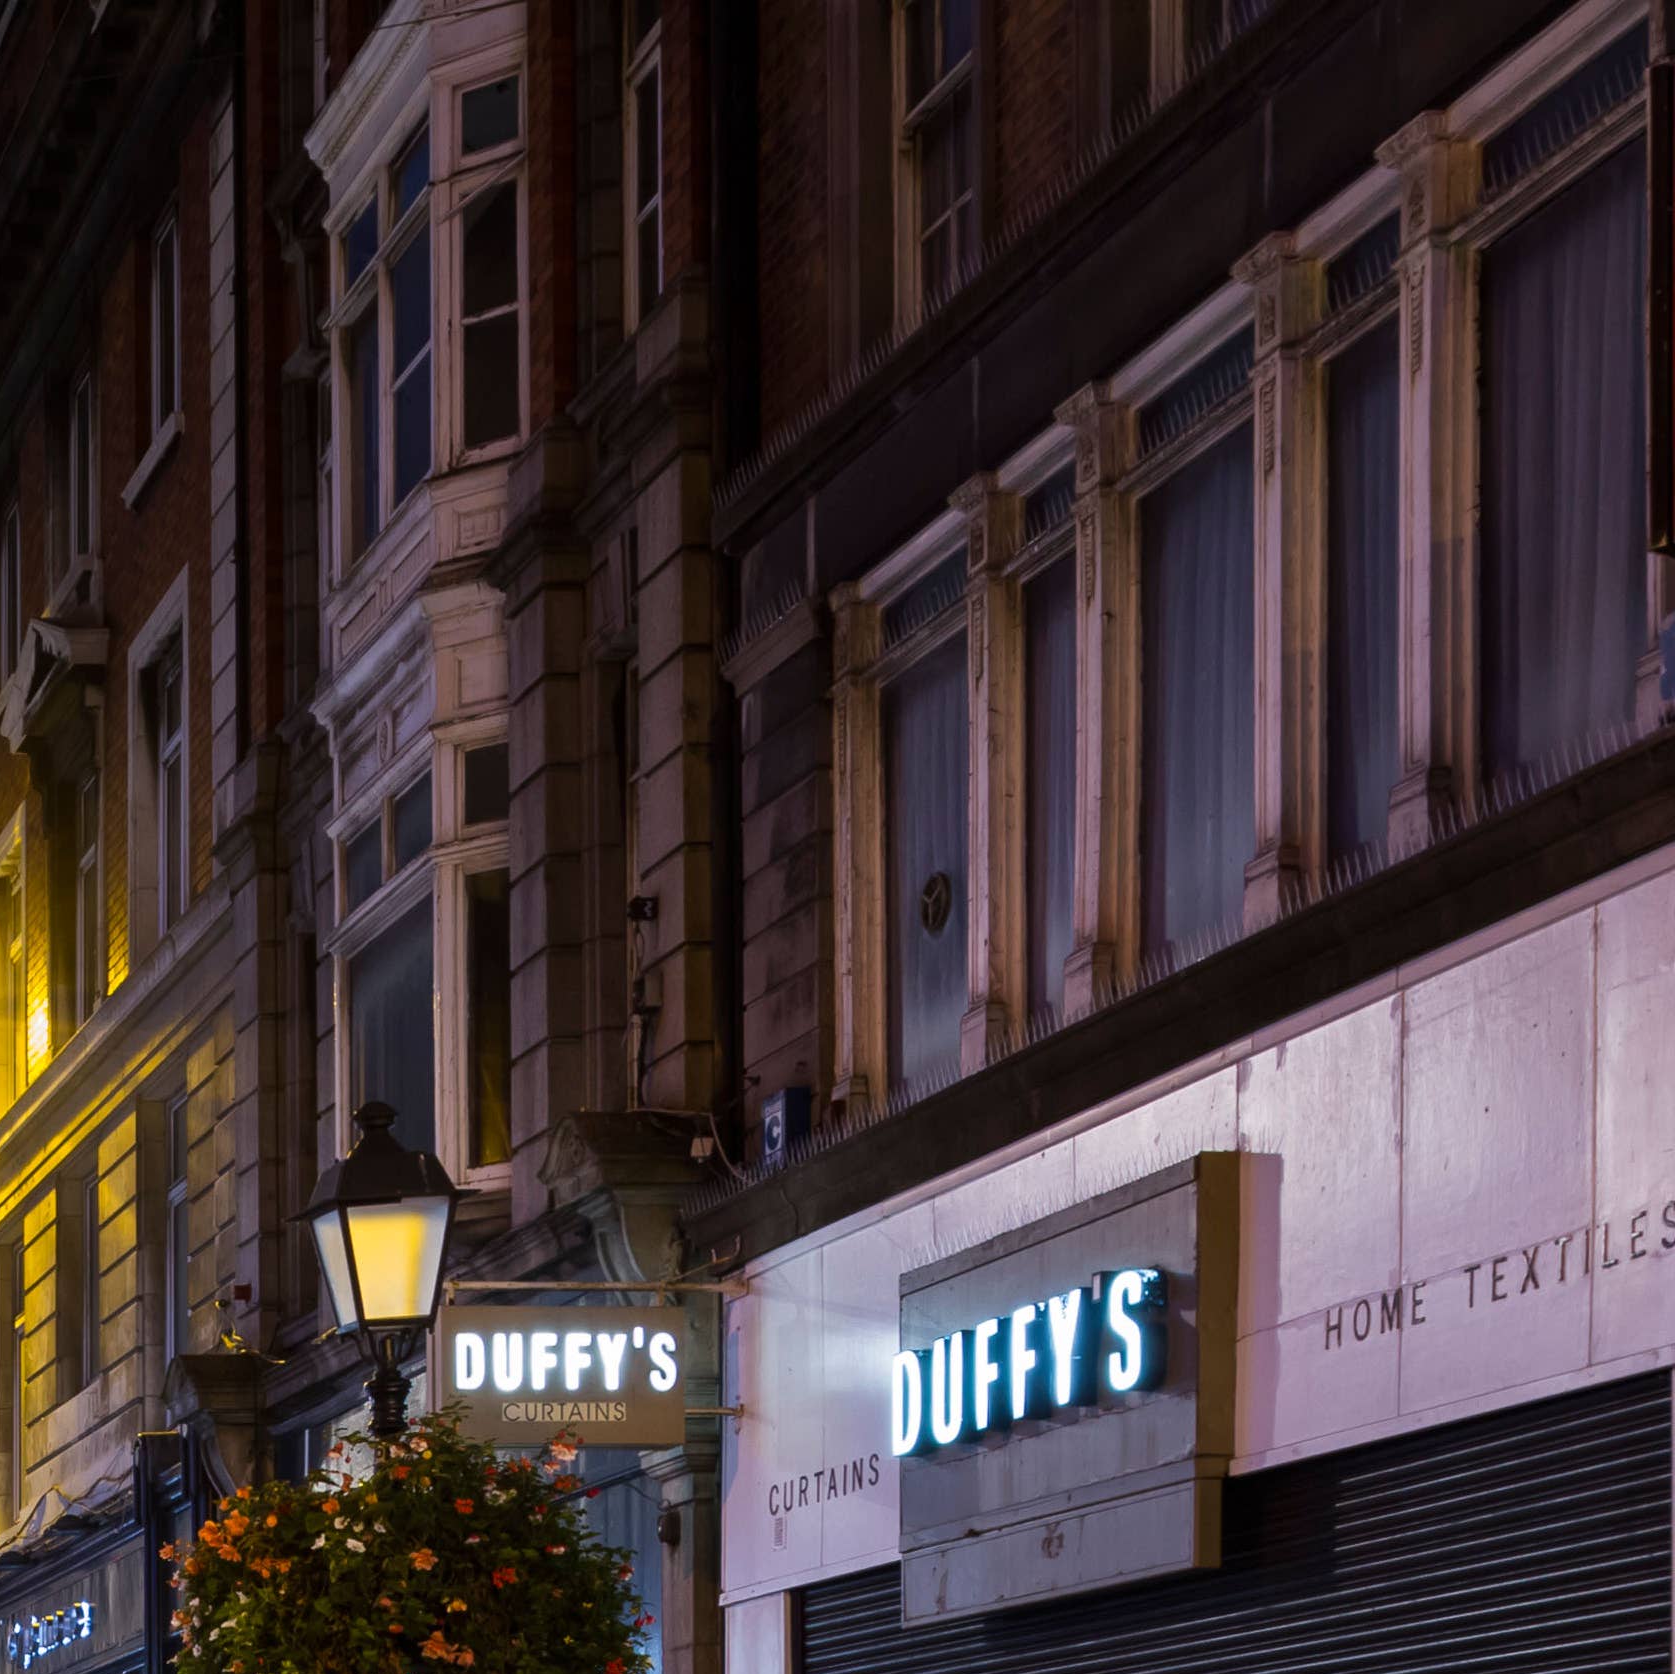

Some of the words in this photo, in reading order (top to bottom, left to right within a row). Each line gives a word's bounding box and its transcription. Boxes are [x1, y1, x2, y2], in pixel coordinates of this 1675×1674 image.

[1325, 1281, 1427, 1351] HOME
[1465, 1200, 1675, 1310] TEXTILES
[454, 1325, 678, 1393] DUFFY'S
[892, 1267, 1164, 1458] DUFFY'S
[502, 1401, 626, 1423] CURTAINS
[768, 1453, 881, 1517] CURTAINS
